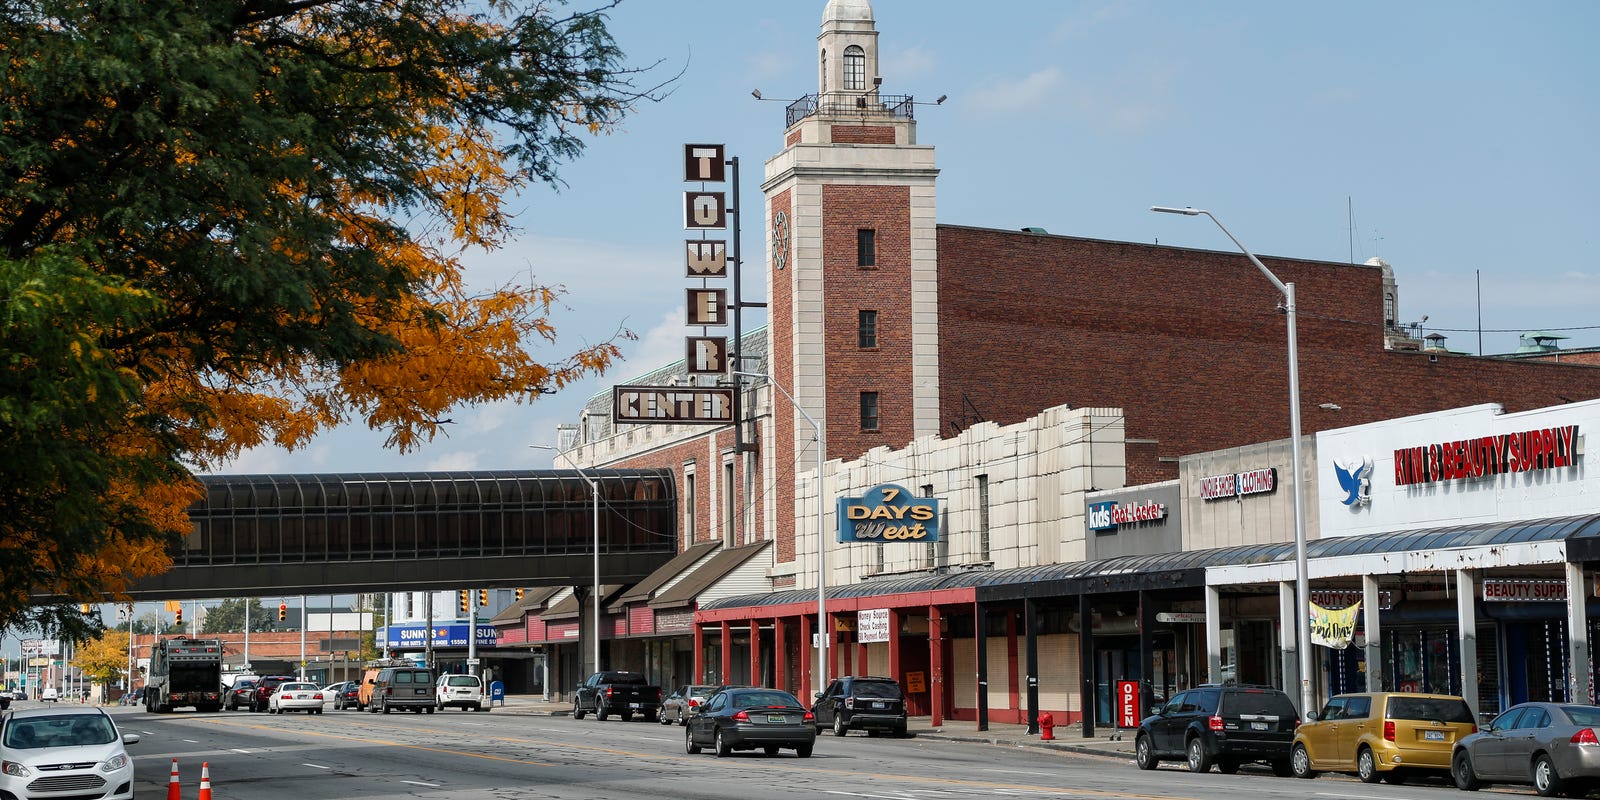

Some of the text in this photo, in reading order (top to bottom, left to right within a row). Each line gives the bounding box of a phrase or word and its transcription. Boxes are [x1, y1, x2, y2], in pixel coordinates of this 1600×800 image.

[687, 147, 726, 371] TOWER
[620, 392, 730, 419] CENTER
[1442, 435, 1505, 480] BEAUTY
[1509, 425, 1574, 473] SUPPLY
[881, 488, 899, 502] 7
[1219, 474, 1235, 497] SHOES
[1242, 468, 1273, 494] CLOTHING
[847, 505, 934, 521] DAYS
[1089, 504, 1110, 528] kids
[1131, 499, 1163, 522] Locker
[855, 521, 927, 540] West
[1310, 593, 1343, 606] EAUTY
[1486, 583, 1529, 597] BEAUTY
[1123, 683, 1134, 727] OPEN
